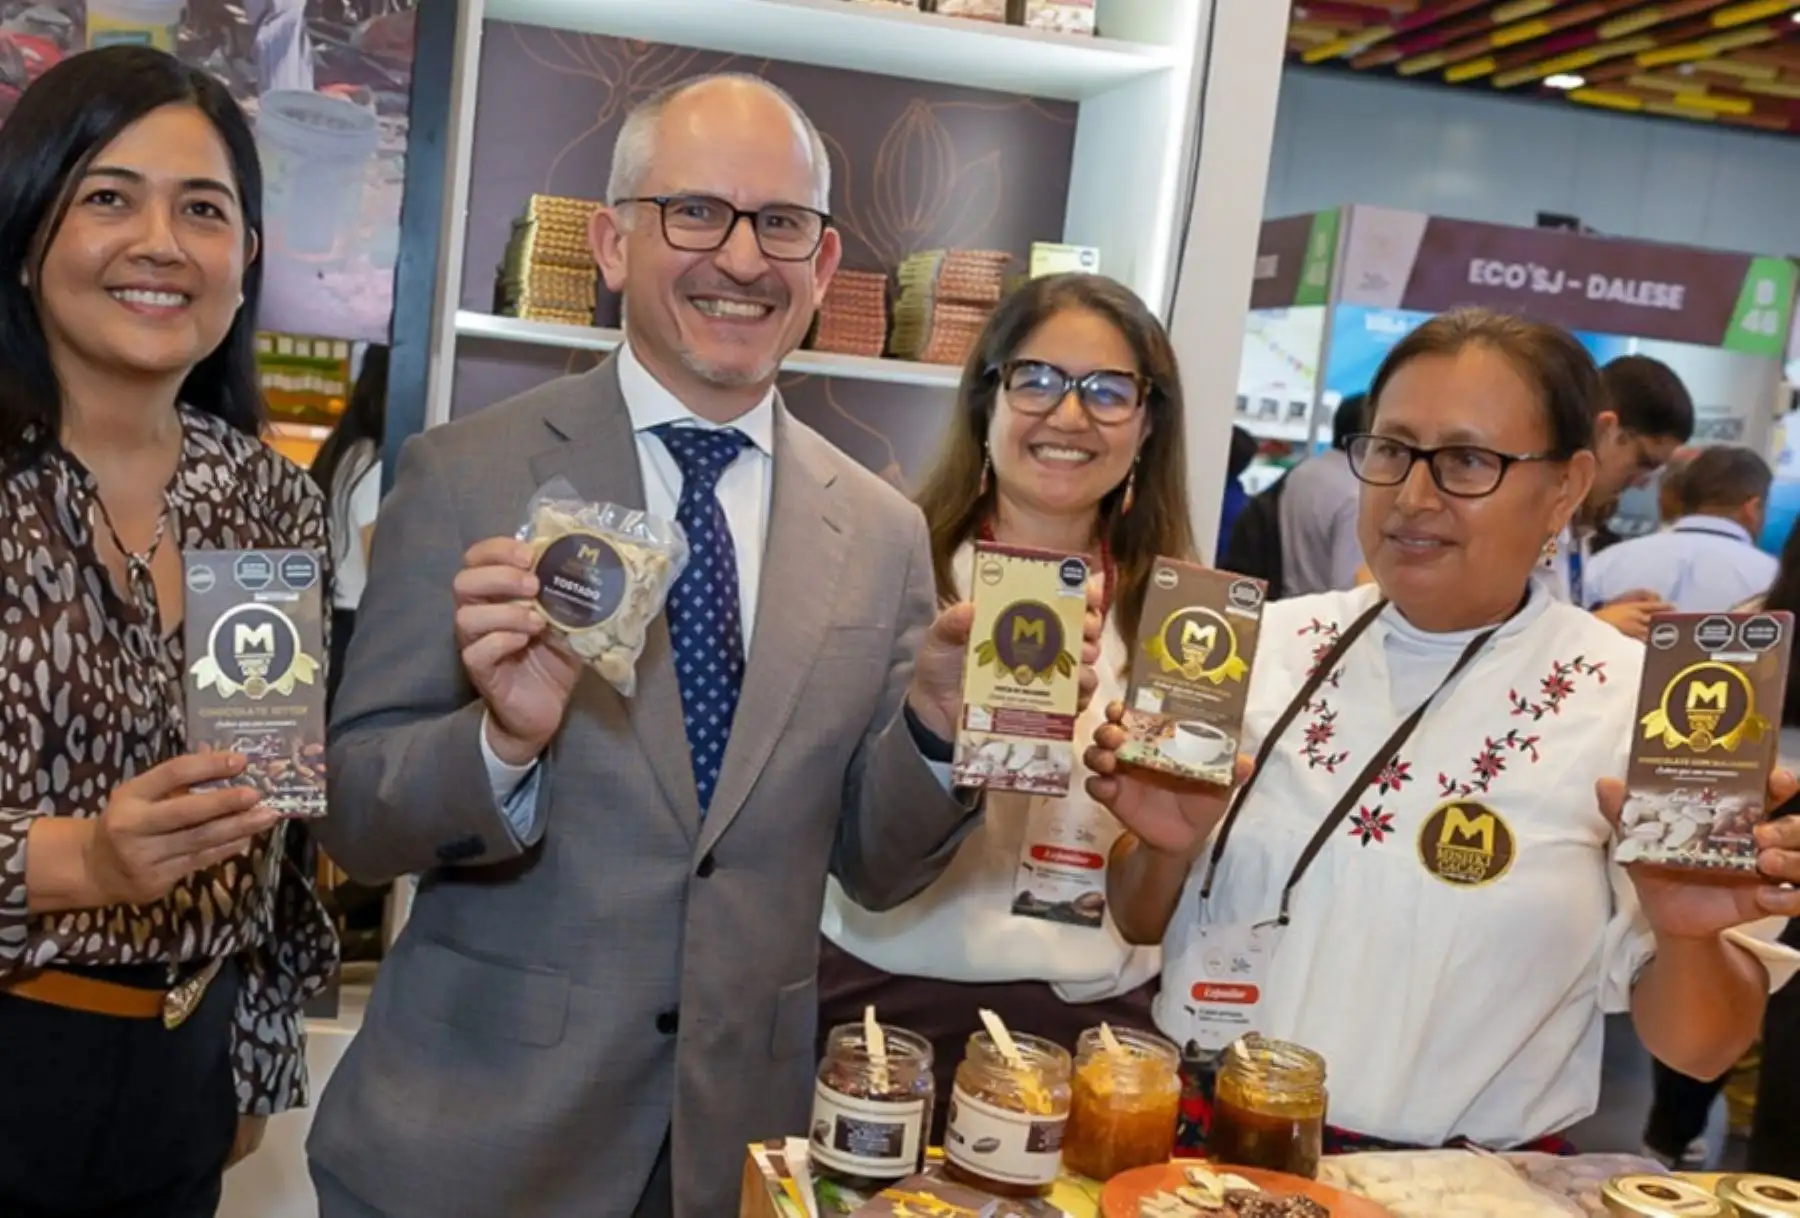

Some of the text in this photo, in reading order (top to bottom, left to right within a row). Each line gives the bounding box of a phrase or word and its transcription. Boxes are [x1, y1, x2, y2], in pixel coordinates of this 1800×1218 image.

[1586, 273, 1686, 310] DALESE
[577, 544, 600, 566] M
[553, 575, 600, 600] TOSTADO
[234, 622, 275, 655] M
[1011, 614, 1047, 646] M
[1181, 619, 1218, 649] M
[1685, 680, 1728, 709] M
[1440, 806, 1495, 856] M
